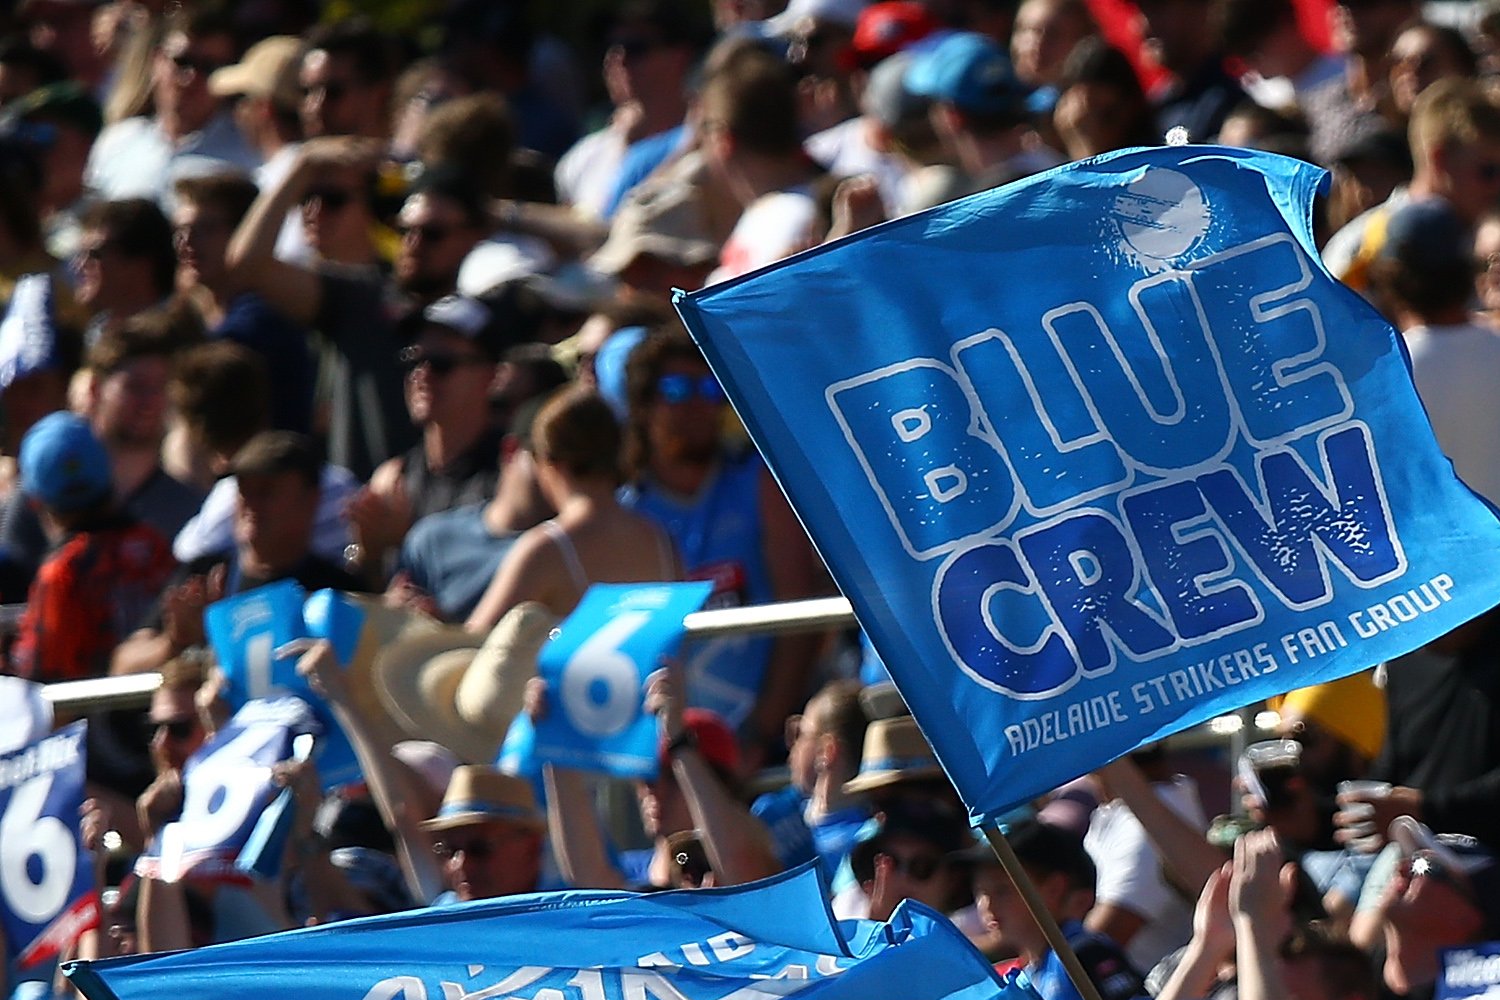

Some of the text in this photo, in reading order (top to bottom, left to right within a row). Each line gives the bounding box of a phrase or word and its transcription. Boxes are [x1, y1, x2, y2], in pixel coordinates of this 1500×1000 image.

[825, 232, 1355, 560] BLUE
[932, 420, 1407, 700] CREW
[562, 612, 651, 737] 6
[1004, 572, 1455, 757] ADELAIDE STRIKERS FAN GROUP
[1, 770, 77, 924] 6
